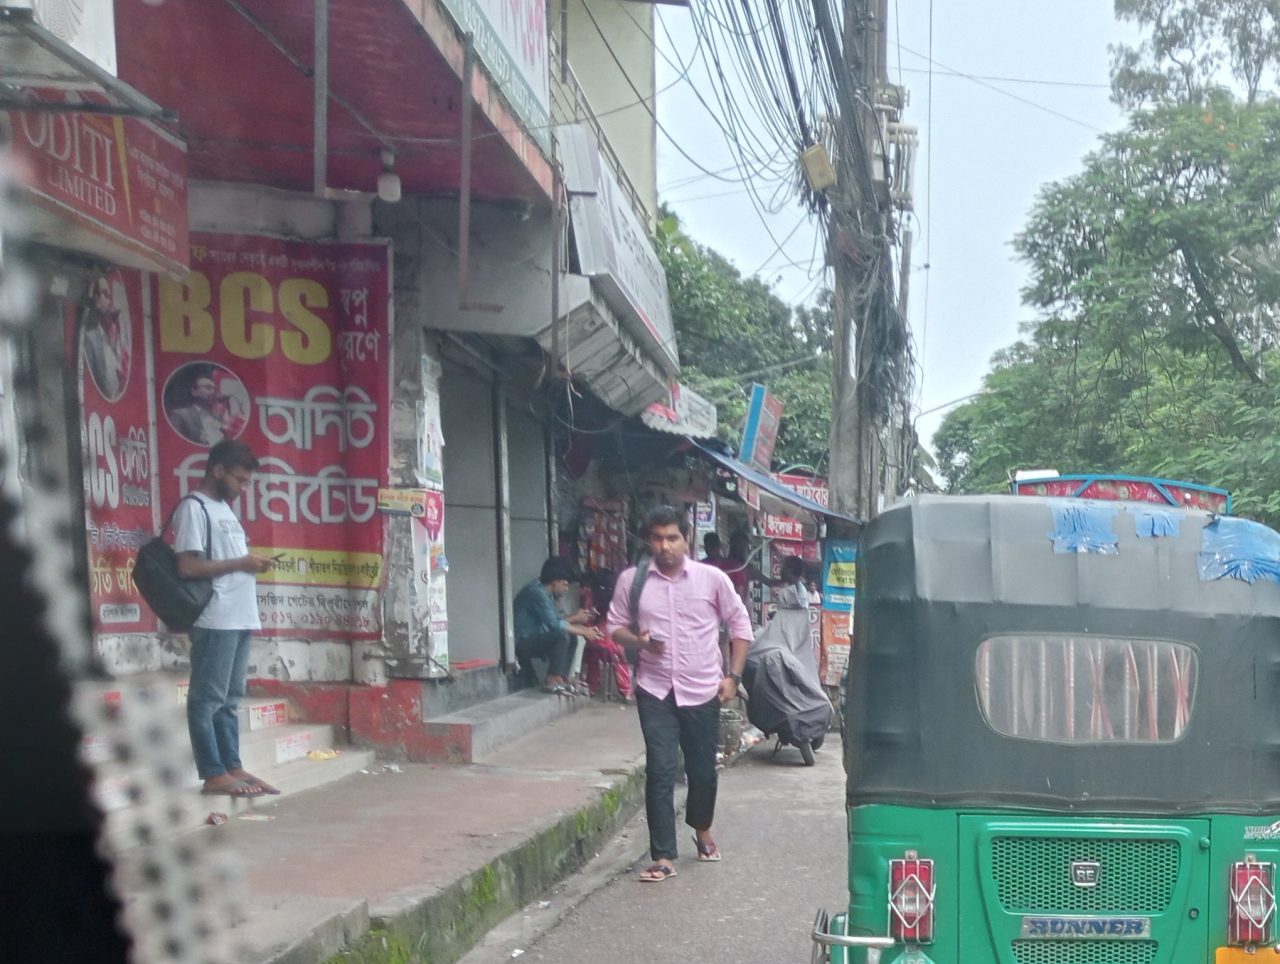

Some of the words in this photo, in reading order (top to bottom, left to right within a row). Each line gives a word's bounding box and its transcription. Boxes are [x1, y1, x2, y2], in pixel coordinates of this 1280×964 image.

[49, 166, 116, 216] LIMITED
[158, 270, 332, 364] BCS
[255, 385, 377, 451] অদিতি
[1076, 869, 1095, 881] RE
[1028, 918, 1145, 936] RUNNER
